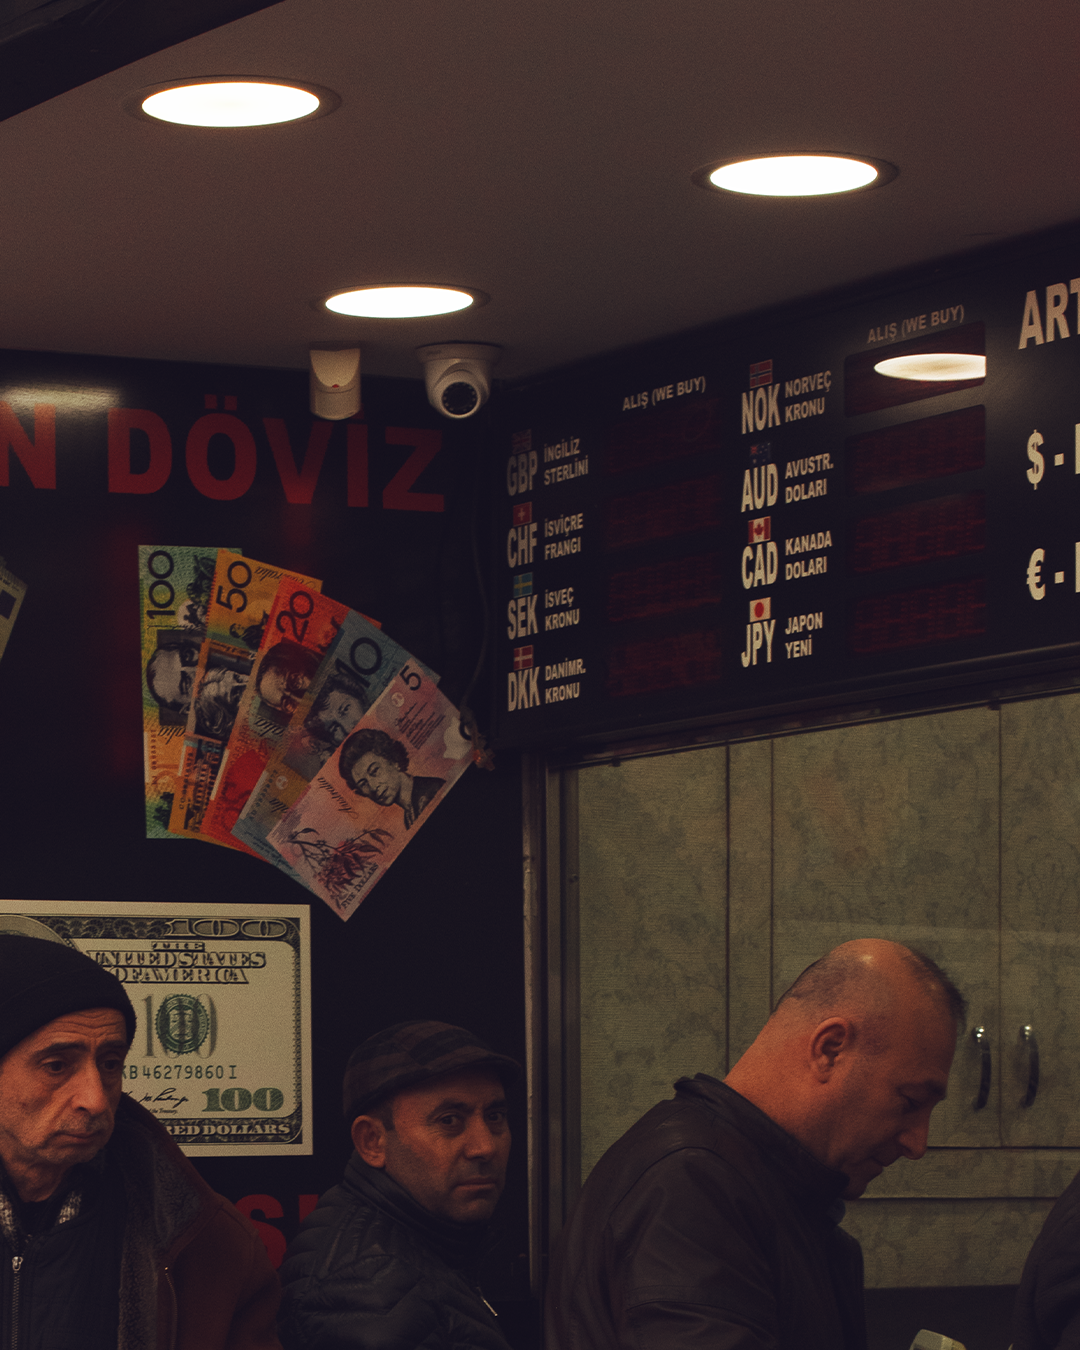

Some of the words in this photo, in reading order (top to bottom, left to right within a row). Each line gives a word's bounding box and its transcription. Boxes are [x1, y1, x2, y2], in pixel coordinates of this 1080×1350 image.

[867, 325, 897, 344] ALIŞ
[901, 314, 927, 339] (WE
[931, 304, 964, 328] BUY)
[622, 392, 648, 412] ALIŞ
[652, 384, 675, 406] (WE
[676, 376, 706, 397] BUY)
[785, 370, 832, 398] NORVEÇ
[741, 383, 781, 435] NOK
[785, 397, 825, 423] KRONU
[106, 394, 446, 514] DÖVİZ
[544, 436, 581, 463] İNGİLİZ
[507, 450, 538, 496] GBP
[544, 455, 588, 486] STERLİNİ
[785, 453, 834, 479] AVUSTR.
[741, 463, 778, 513] AUD
[785, 478, 827, 504] DOLARI
[545, 513, 584, 538] İSVİÇRE
[507, 522, 538, 568] CHF
[545, 536, 581, 560] FRANGI
[785, 530, 833, 556] KANADA
[741, 541, 778, 590] CAD
[785, 556, 827, 581] DOLARI
[147, 550, 175, 620] 100
[216, 560, 252, 613] 50
[545, 587, 574, 608] İSVEÇ
[276, 590, 314, 642] 20
[507, 594, 539, 640] SEK
[545, 608, 580, 631] KRONU
[785, 611, 823, 635] JAPON
[741, 619, 776, 668] JPY
[785, 634, 812, 659] YENİ
[335, 637, 382, 688] 10
[545, 657, 586, 681] DANİMR.
[399, 665, 422, 691] 5
[508, 666, 541, 712] DKK
[545, 682, 580, 704] KRONU
[165, 918, 287, 938] 100
[179, 952, 266, 968] STATES
[142, 968, 249, 984] AMERICA
[143, 1065, 224, 1079] 46279860
[202, 1087, 284, 1112] 100
[202, 1124, 291, 1135] DOLLARS
